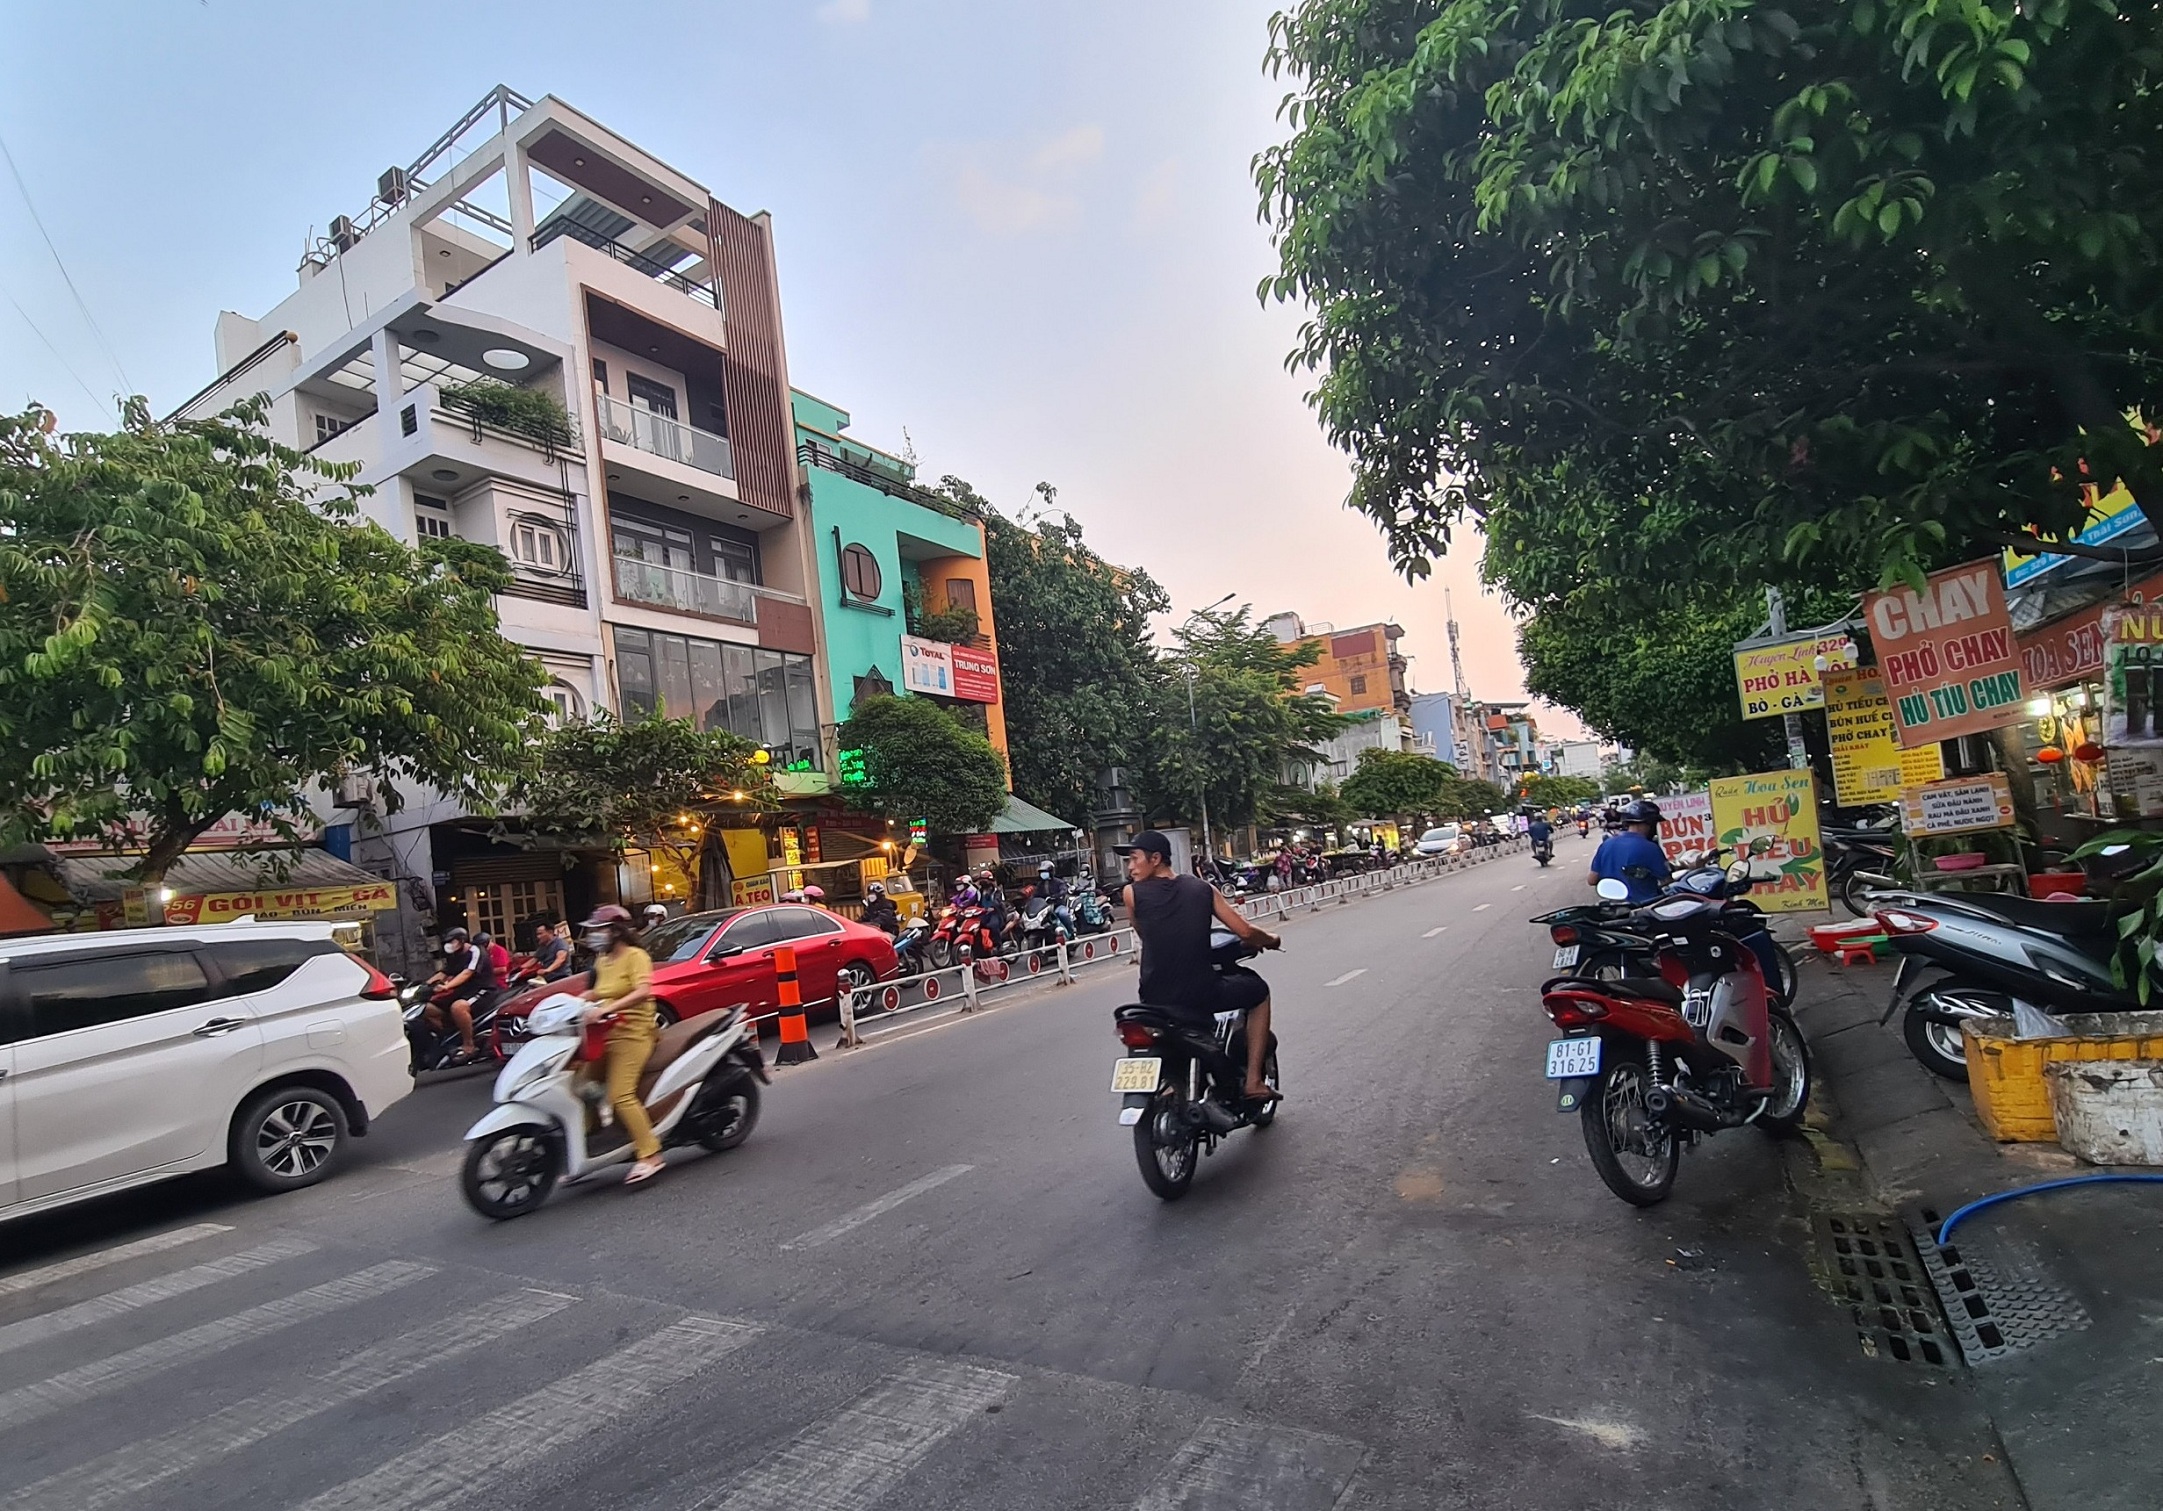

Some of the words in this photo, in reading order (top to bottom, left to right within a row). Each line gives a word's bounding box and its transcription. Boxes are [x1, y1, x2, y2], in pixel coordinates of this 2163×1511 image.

[1872, 569, 1990, 640] CHAY
[1820, 637, 1848, 653] 329
[1885, 640, 1940, 687] PHỞ
[1943, 626, 2011, 672] CHAY
[954, 659, 980, 673] TRUNG
[980, 663, 996, 676] SƠN
[1856, 667, 1882, 681] HO
[1743, 668, 1780, 693] PHỞ
[1784, 665, 1812, 686] HÀ
[1748, 697, 1769, 714] BÒ
[1781, 692, 1804, 708] GÀ
[1828, 699, 1844, 713] HỦ
[1846, 695, 1873, 710] TIẾU
[1899, 686, 1930, 728] HỦ
[1930, 681, 1968, 720] TÍU
[1968, 670, 2023, 711] CHAY
[1830, 716, 1853, 728] BÚN
[1856, 709, 1878, 724] HUẾ
[1832, 729, 1854, 743] PHỞ
[1857, 728, 1887, 740] CHAY
[1744, 780, 1777, 795] Hoa
[1781, 775, 1809, 790] Sen
[1686, 796, 1705, 808] LINH
[1922, 793, 1937, 801] CAM
[1743, 796, 1791, 827] HỦ
[1928, 811, 1942, 819] RAU
[1971, 806, 1991, 814] XANH
[1660, 812, 1704, 840] BÚN
[1750, 871, 1823, 895] HAY
[208, 891, 264, 912] GỎI
[274, 891, 321, 909] VỊT
[352, 886, 390, 901] GÀ
[292, 906, 321, 917] BÚN
[1556, 1040, 1591, 1058] 81-G1
[1550, 1056, 1595, 1075] 316.25
[1115, 1075, 1155, 1090] 229.81
